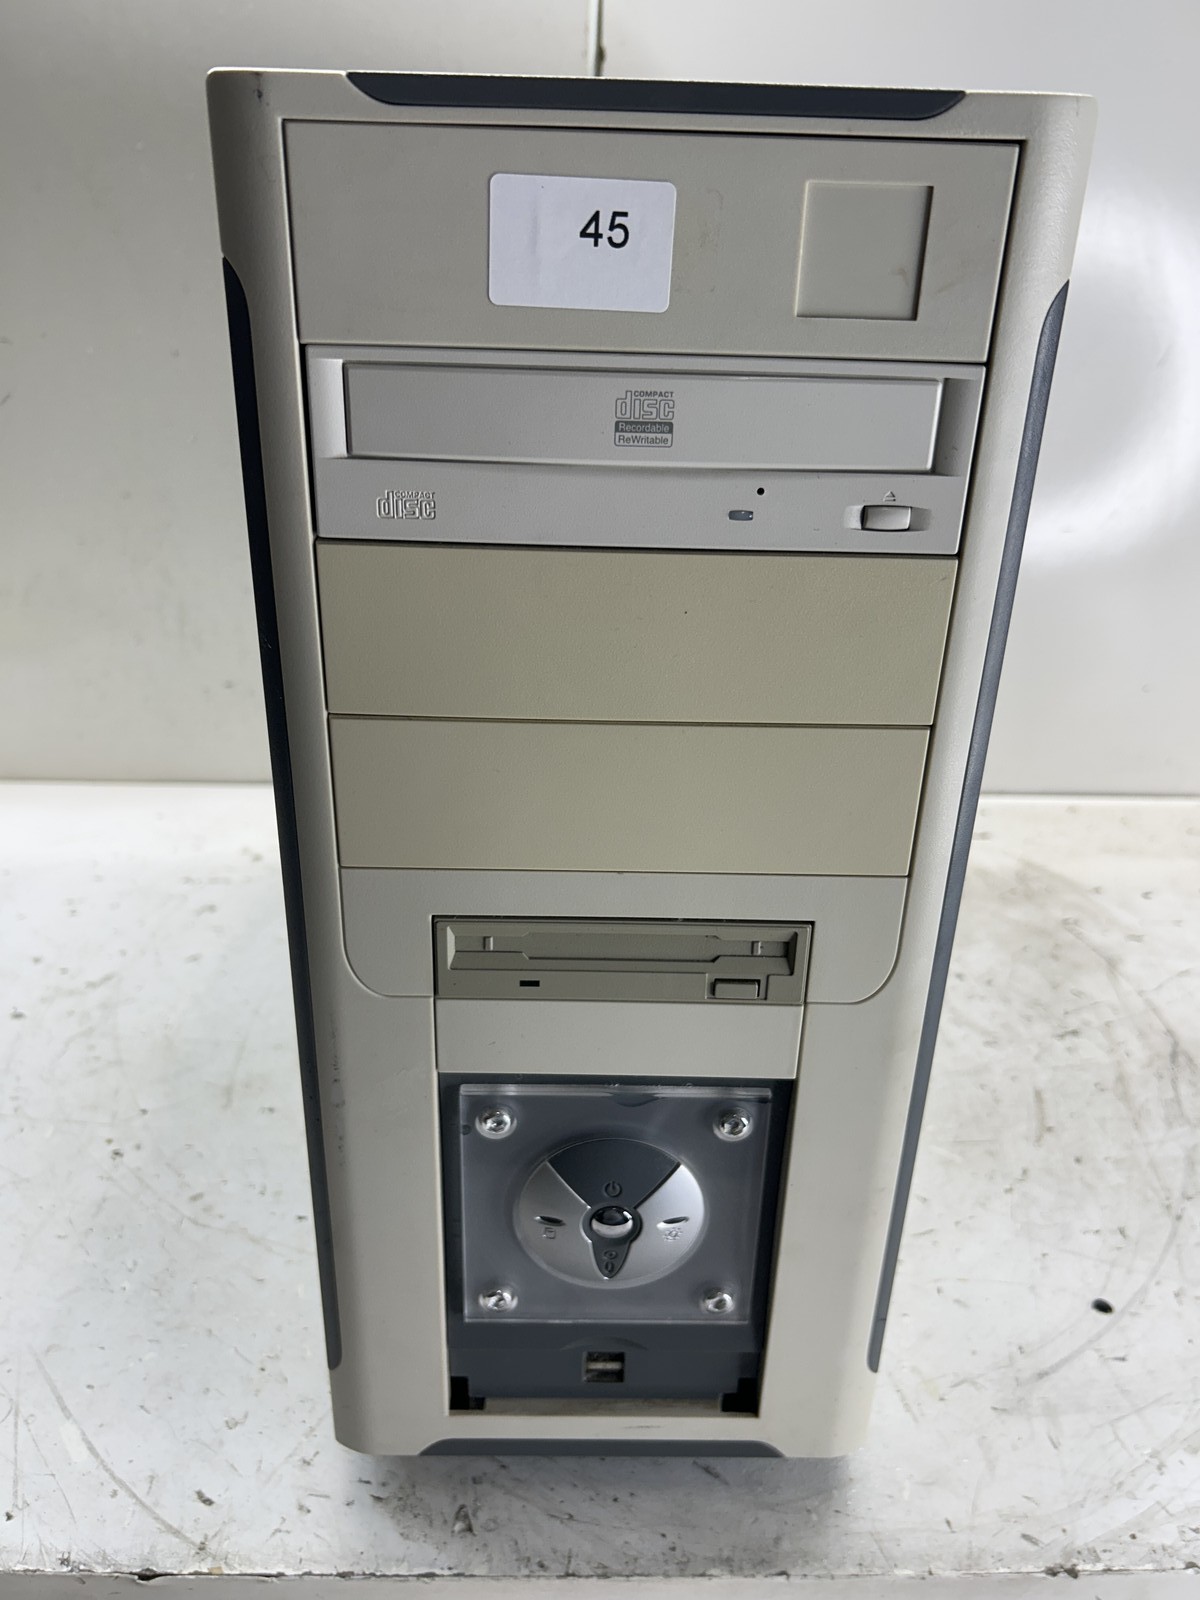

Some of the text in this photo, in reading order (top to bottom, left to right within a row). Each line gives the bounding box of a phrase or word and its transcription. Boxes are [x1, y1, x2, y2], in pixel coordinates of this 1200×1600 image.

[579, 210, 630, 249] 45
[633, 390, 674, 398] COMPACT
[618, 422, 670, 433] Recordable
[618, 434, 669, 445] ReWritable
[394, 491, 436, 499] COMPACT
